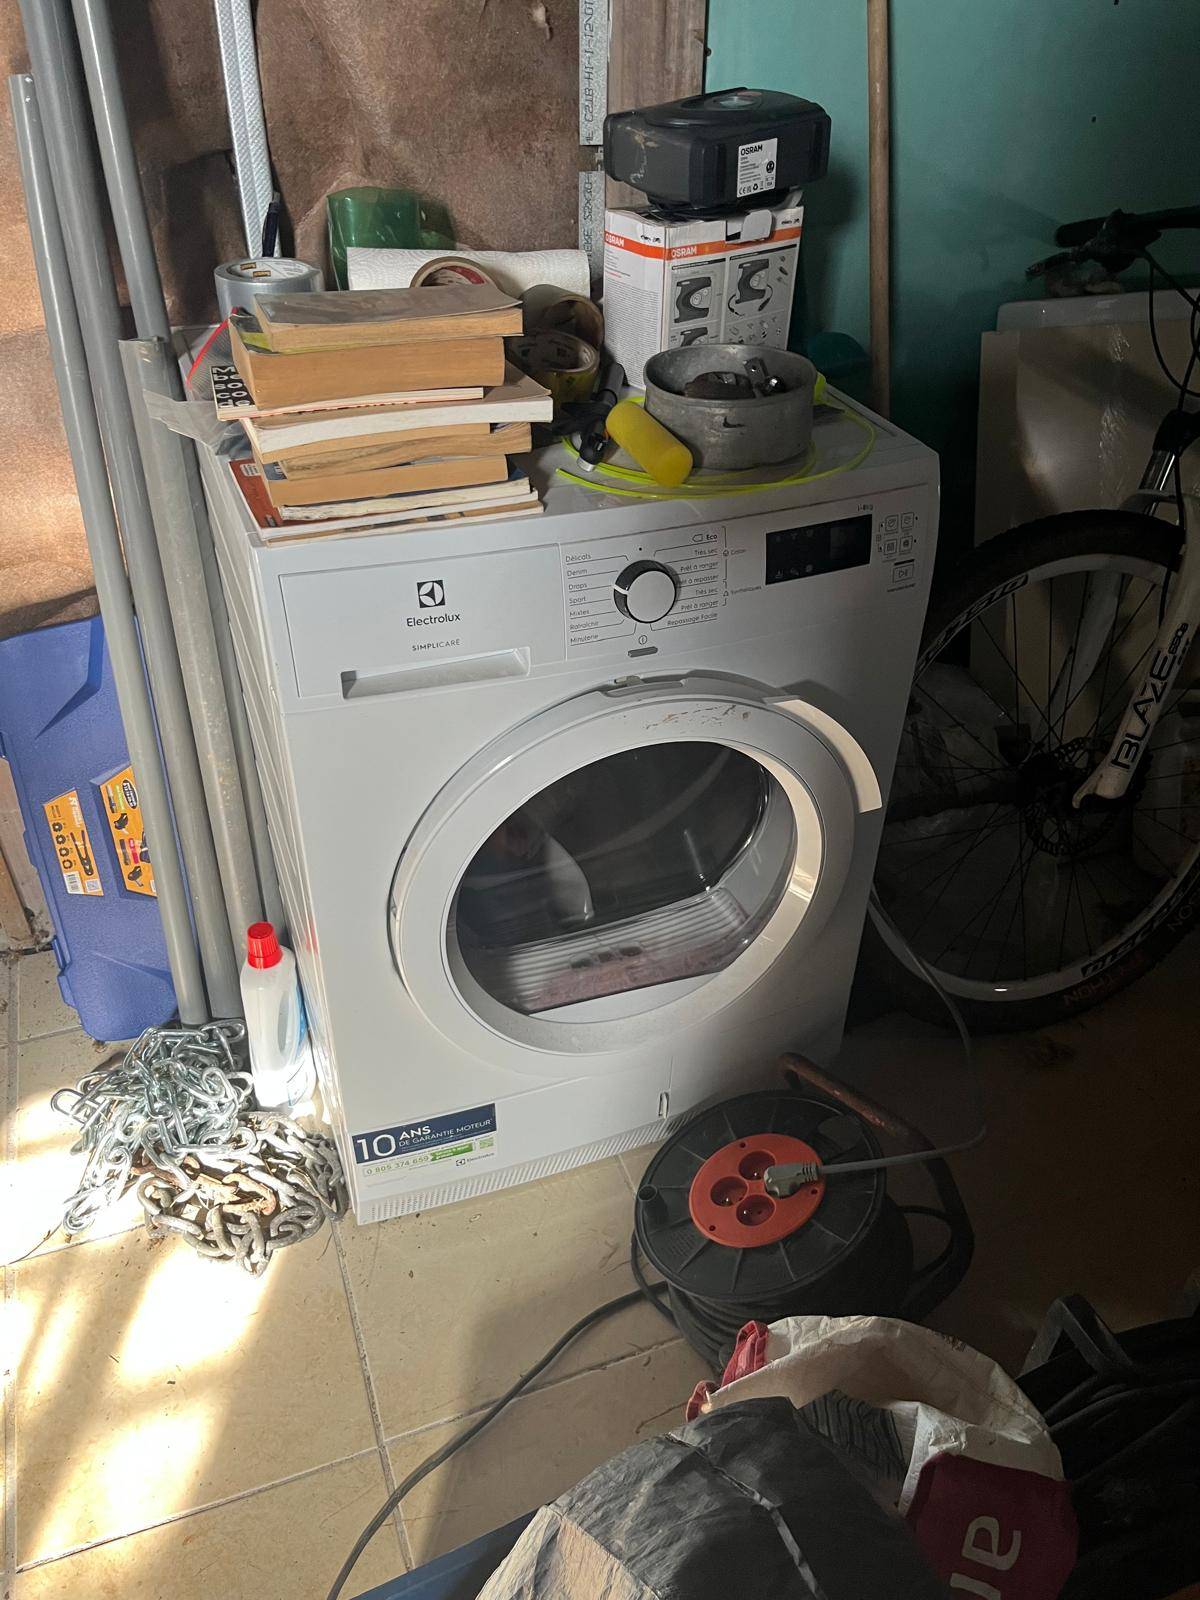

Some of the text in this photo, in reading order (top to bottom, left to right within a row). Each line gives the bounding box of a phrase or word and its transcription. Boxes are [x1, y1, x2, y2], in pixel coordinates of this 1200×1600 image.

[740, 144, 763, 156] OSRAM
[605, 233, 625, 248] OSRAM
[671, 245, 698, 259] OSRAM
[567, 568, 588, 577] Denim
[568, 596, 586, 605] Sport
[406, 612, 462, 627] Electrolux
[411, 638, 461, 652] SIMPLICARE
[1110, 650, 1177, 770] BLAZE
[356, 1133, 397, 1161] 10
[399, 1125, 432, 1141] ANS
[398, 1139, 411, 1147] DE
[412, 1128, 455, 1145] GARANTIE
